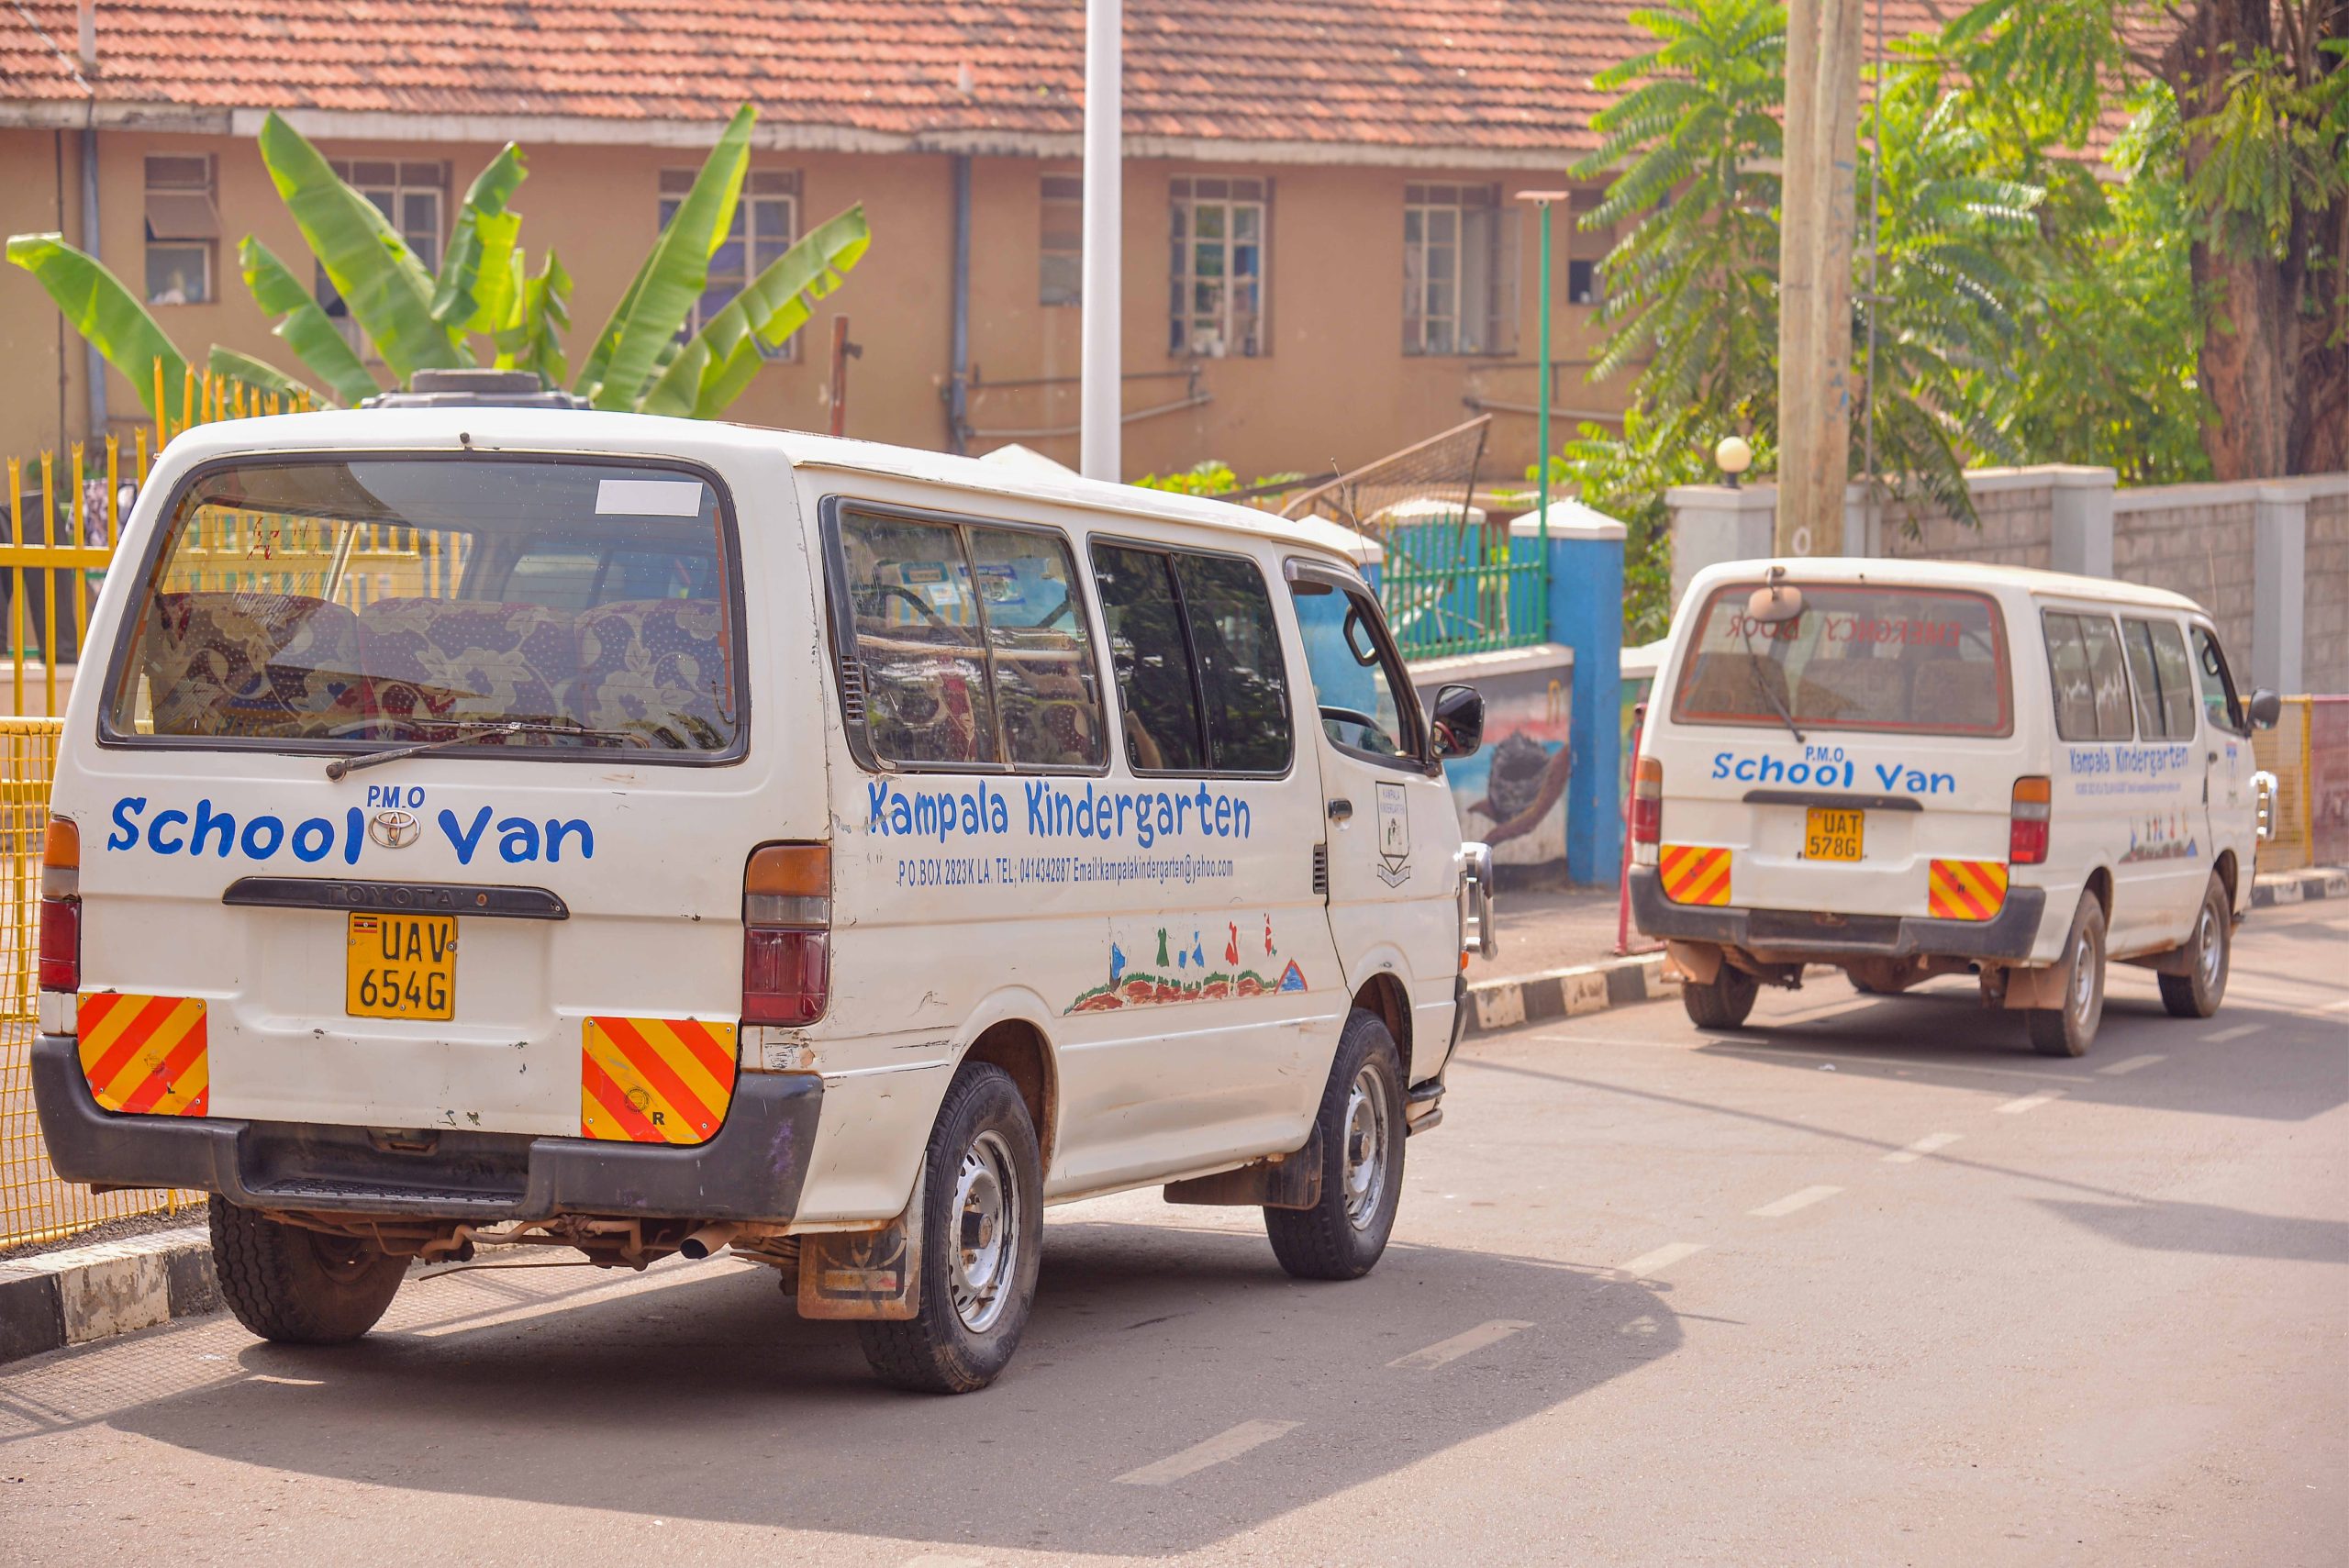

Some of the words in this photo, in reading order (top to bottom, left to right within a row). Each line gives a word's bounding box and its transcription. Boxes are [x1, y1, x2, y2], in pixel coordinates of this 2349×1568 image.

[1806, 746, 1843, 762] P.M.O
[1712, 752, 1854, 788] School
[1876, 763, 1955, 794] Van
[367, 785, 426, 808] P.M.O
[868, 780, 1008, 844] Kampala
[1025, 779, 1251, 849] Kindergarten
[1824, 812, 1860, 835] UAT
[107, 797, 365, 865] School
[438, 806, 594, 865] Van
[1809, 836, 1857, 857] 578G
[1019, 857, 1071, 884] 0414342887
[326, 884, 456, 907] TOYOTA
[382, 921, 448, 962] UAV
[361, 969, 446, 1010] 654G
[652, 1111, 665, 1126] R
